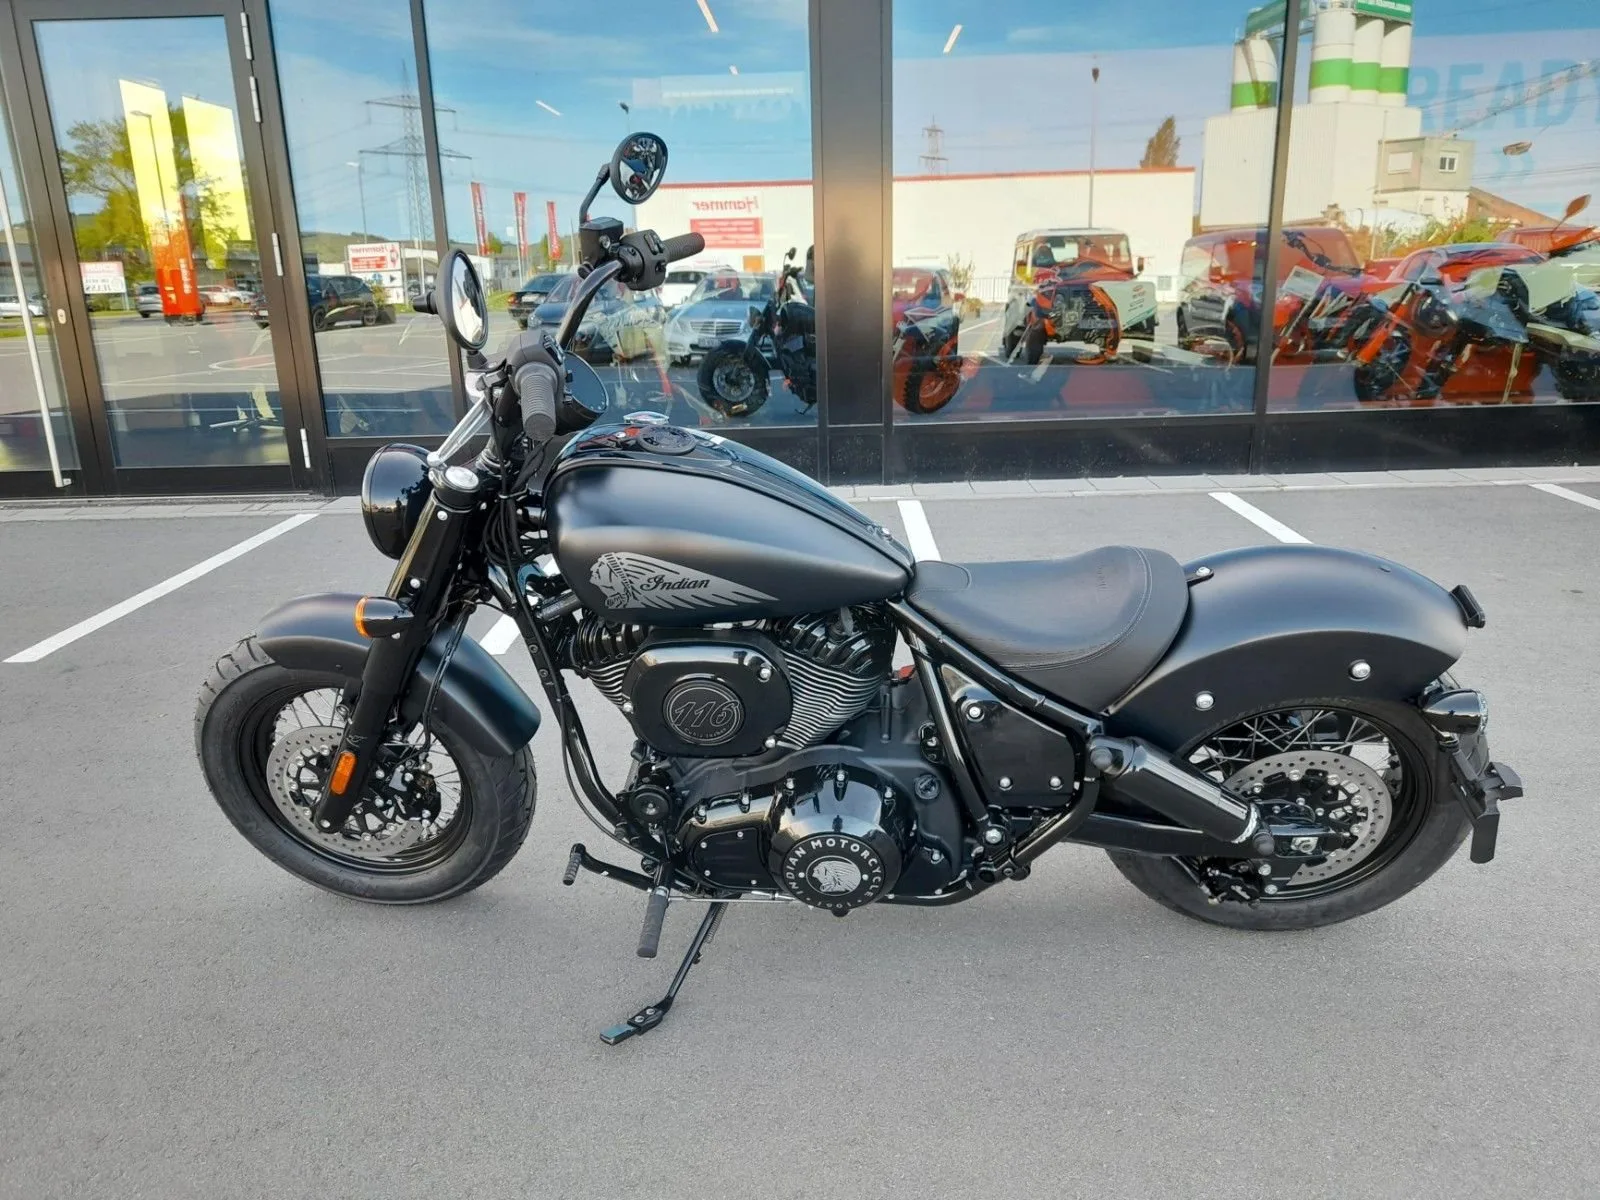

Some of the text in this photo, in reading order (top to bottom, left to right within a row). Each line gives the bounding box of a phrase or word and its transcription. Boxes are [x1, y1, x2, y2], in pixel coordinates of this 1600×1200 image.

[1407, 58, 1600, 132] READ
[640, 574, 711, 591] Indian
[674, 700, 740, 728] 116
[786, 838, 882, 897] INDIAN MOTORCYCLE
